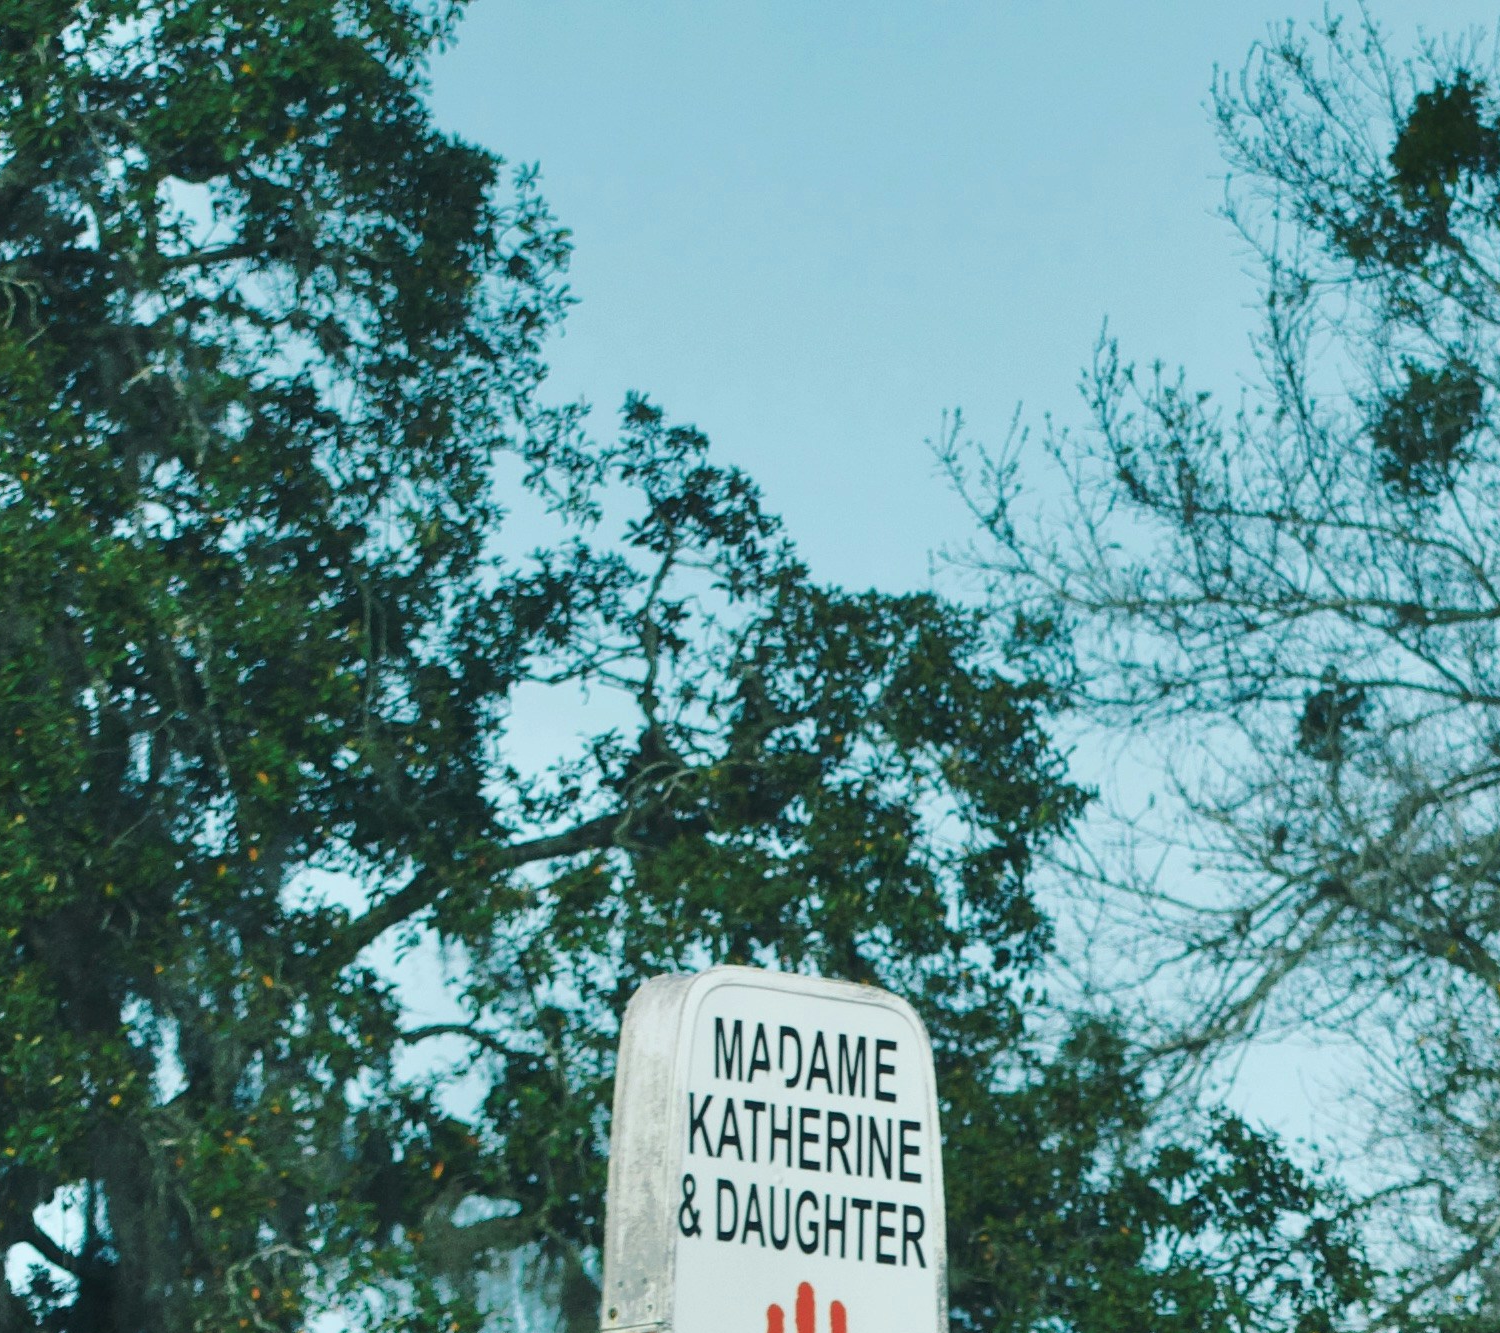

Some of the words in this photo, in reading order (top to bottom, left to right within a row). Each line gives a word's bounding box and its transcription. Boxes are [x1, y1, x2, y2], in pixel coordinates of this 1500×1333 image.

[714, 1016, 898, 1104] MADAME
[688, 1091, 923, 1185] KATHERINE
[678, 1173, 703, 1239] &
[716, 1177, 927, 1269] DAUGHTER
